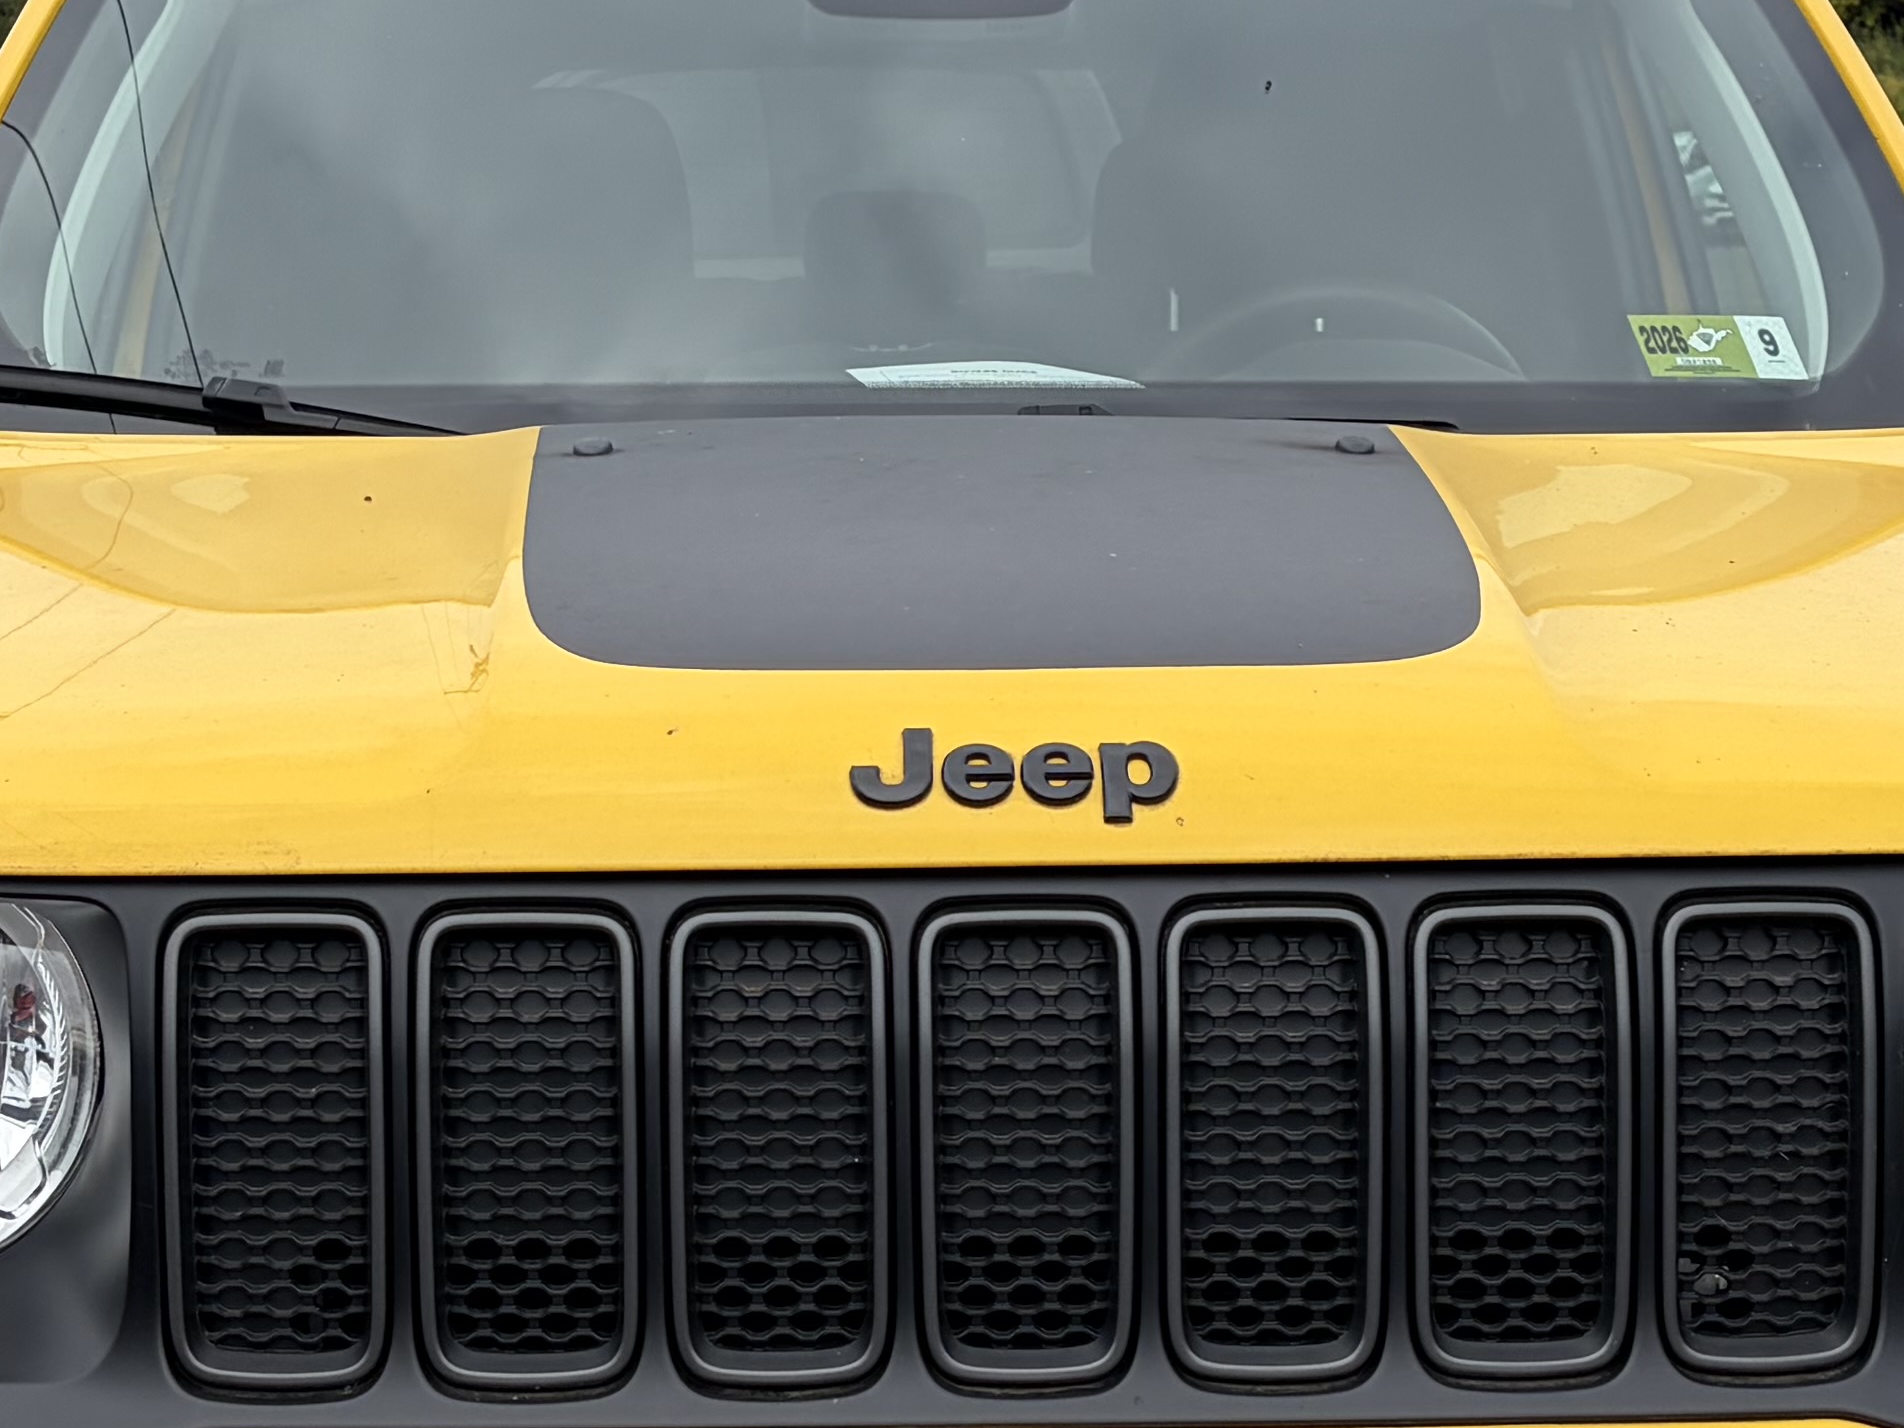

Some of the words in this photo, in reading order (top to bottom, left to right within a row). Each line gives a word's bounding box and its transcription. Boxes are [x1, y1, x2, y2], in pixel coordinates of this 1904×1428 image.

[1637, 324, 1690, 355] 2026
[1756, 327, 1780, 357] 9
[848, 726, 1180, 826] Jeep
